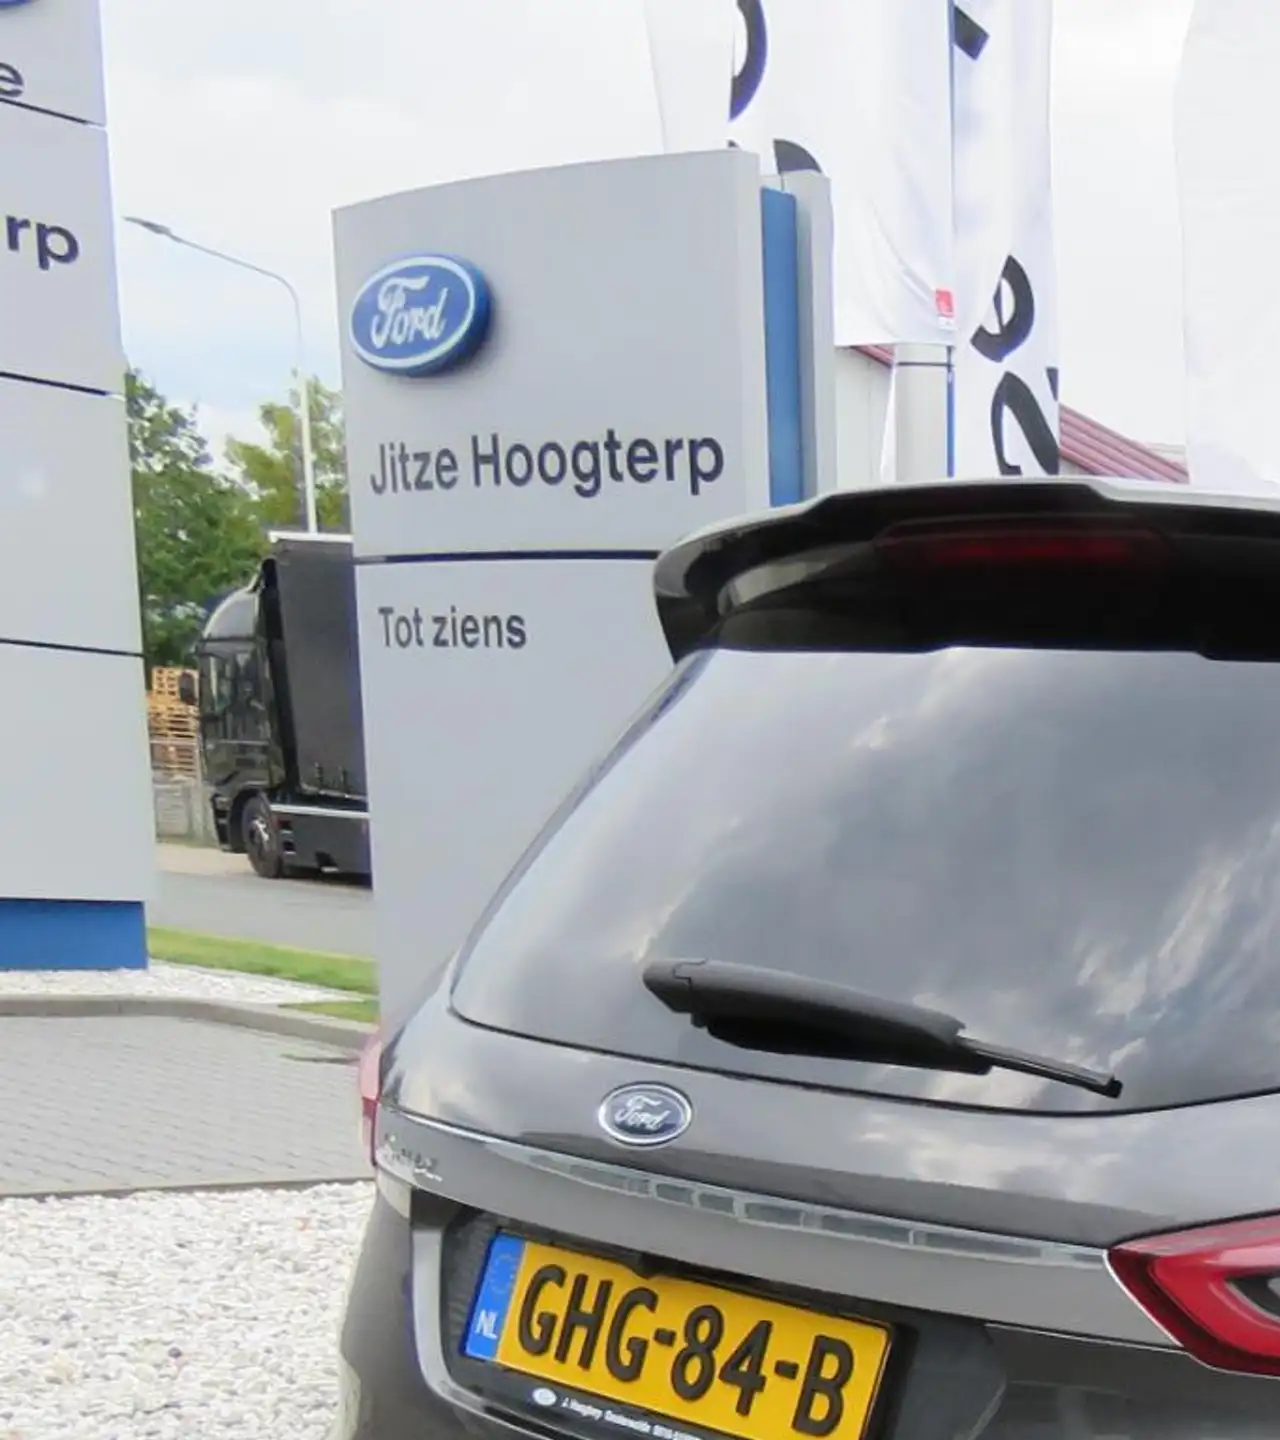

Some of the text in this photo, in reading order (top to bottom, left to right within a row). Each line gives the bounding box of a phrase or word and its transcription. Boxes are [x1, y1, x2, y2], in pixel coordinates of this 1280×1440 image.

[370, 275, 448, 349] Ford
[370, 428, 725, 499] Jitze Hoogterp
[378, 604, 527, 650] Tot ziens
[475, 1308, 499, 1340] NL
[517, 1263, 855, 1438] GHG-84-B
